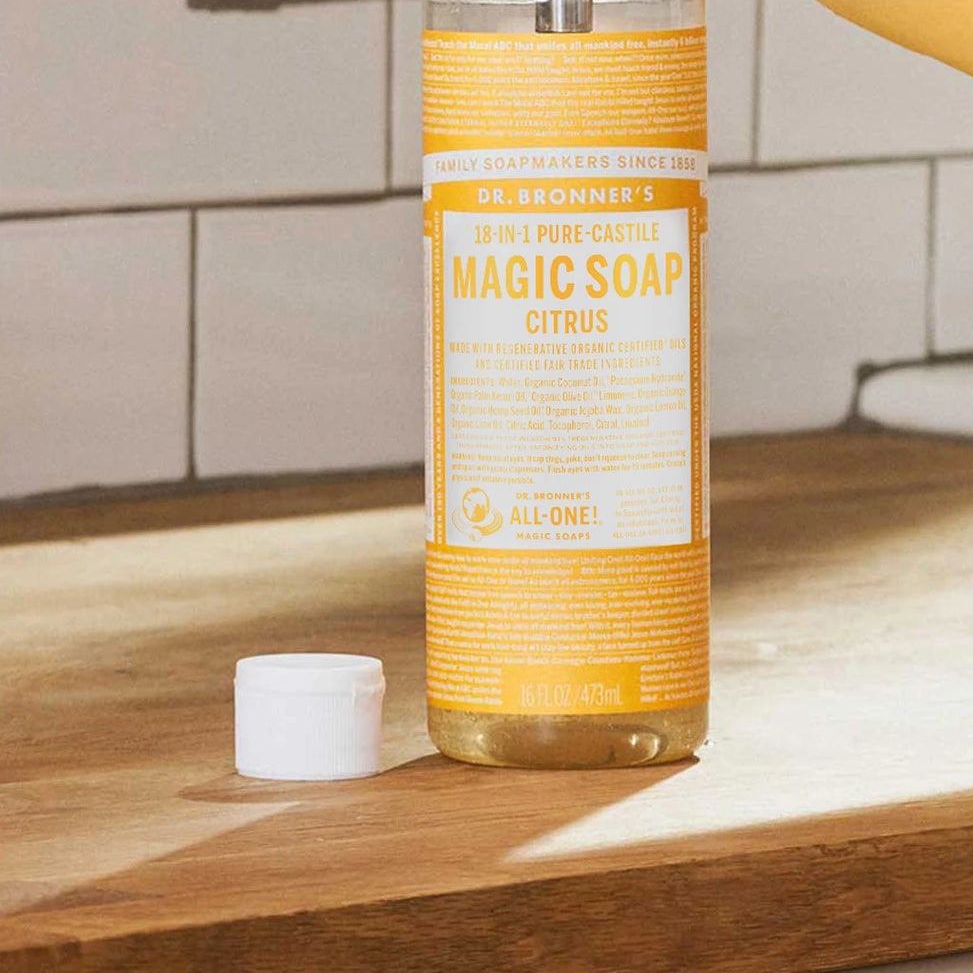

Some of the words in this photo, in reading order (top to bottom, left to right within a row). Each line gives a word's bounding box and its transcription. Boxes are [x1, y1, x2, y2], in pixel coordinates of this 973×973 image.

[435, 159, 477, 173] FAMILY
[483, 155, 611, 171] SOAPMAKERS
[617, 155, 666, 169] SINCE
[671, 157, 696, 171] 1858
[478, 188, 512, 204] DR.
[518, 185, 654, 205] BRONNER'S
[474, 224, 530, 244] 18-IN-1
[537, 222, 660, 244] PURE-CASTILE
[453, 254, 575, 300] MAGIC
[585, 251, 683, 300] SOAP
[526, 309, 608, 334] CITRUS
[571, 341, 615, 355] ORGANIC
[544, 359, 565, 371] FAIR
[568, 358, 597, 371] TRADE
[510, 505, 598, 526] ALL-ONE!
[516, 532, 551, 540] MAGIC
[555, 532, 591, 540] SOAPS
[520, 684, 534, 708] 16
